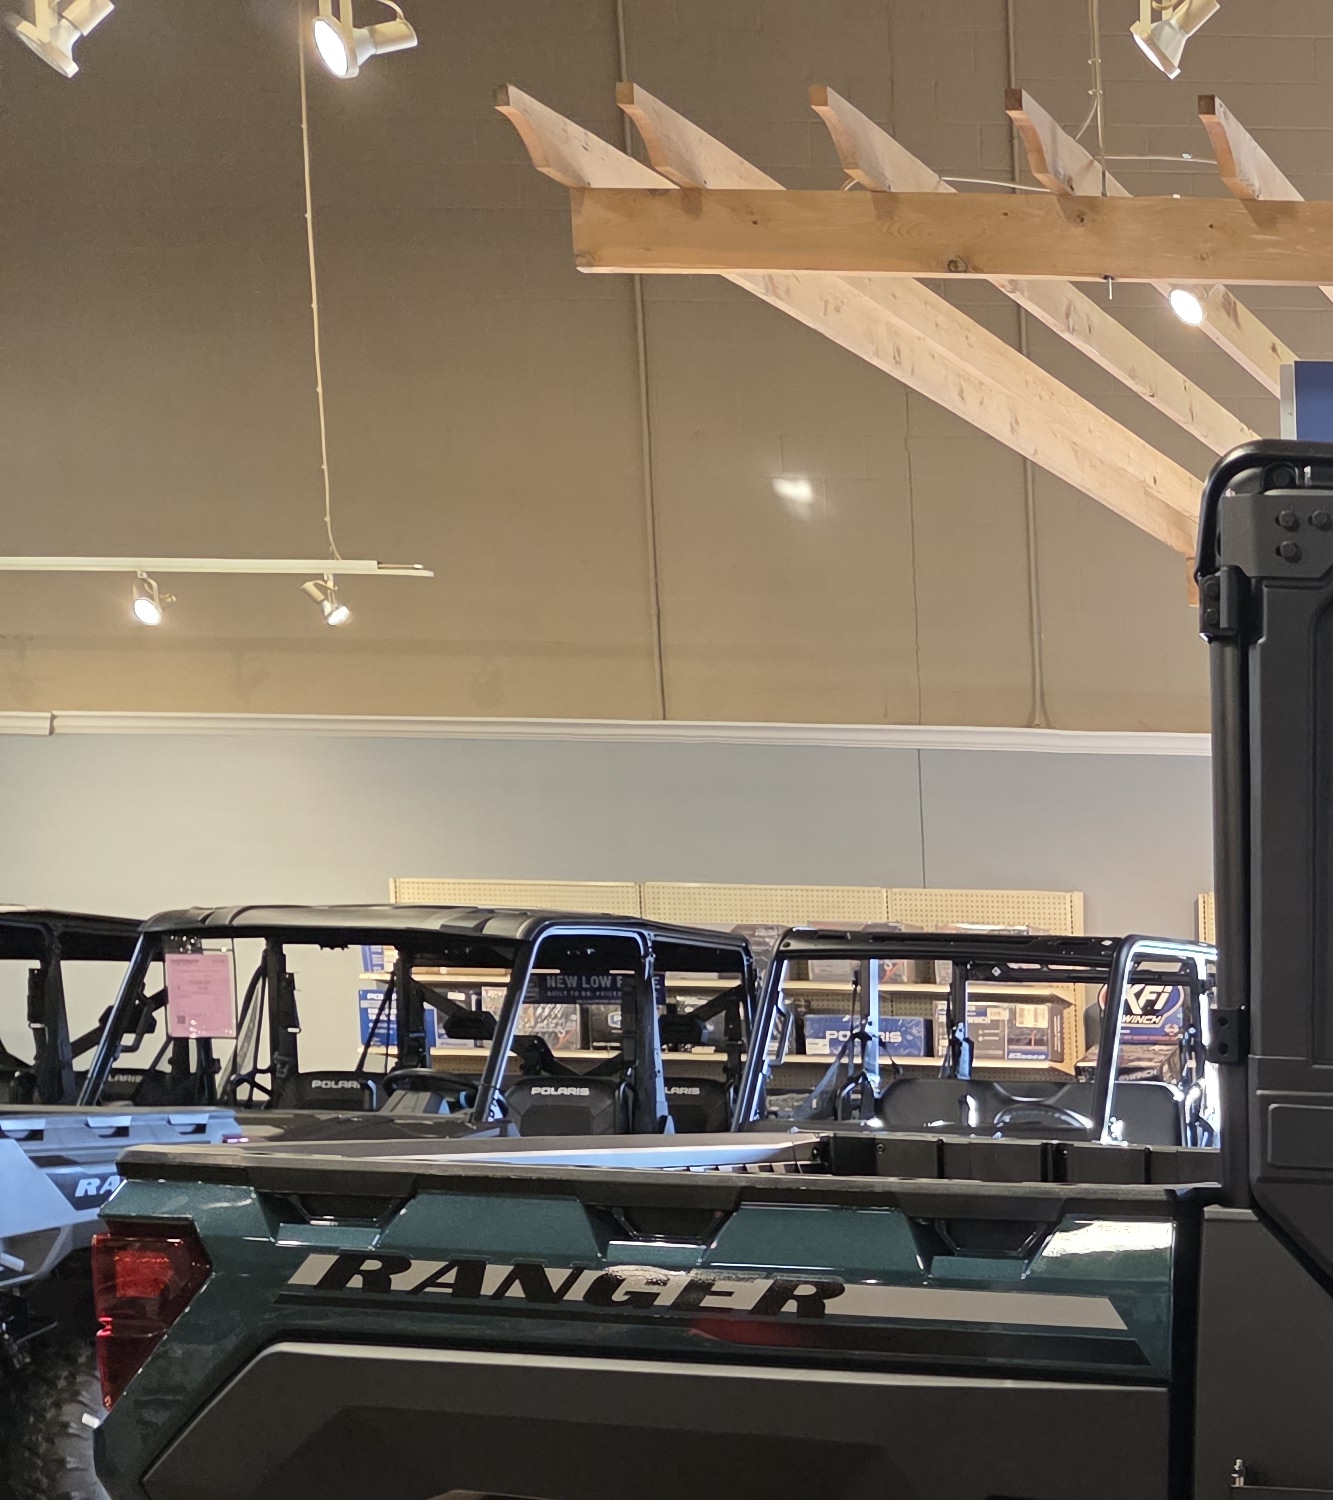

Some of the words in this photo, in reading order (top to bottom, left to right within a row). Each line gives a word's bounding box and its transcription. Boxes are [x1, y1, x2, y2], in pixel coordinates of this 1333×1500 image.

[547, 976, 577, 988] NEW
[582, 976, 612, 988] LOW
[1121, 1014, 1162, 1024] WINCH
[531, 1086, 590, 1096] POLARIS
[664, 1087, 700, 1095] LARIS
[312, 1249, 847, 1319] RANGER
